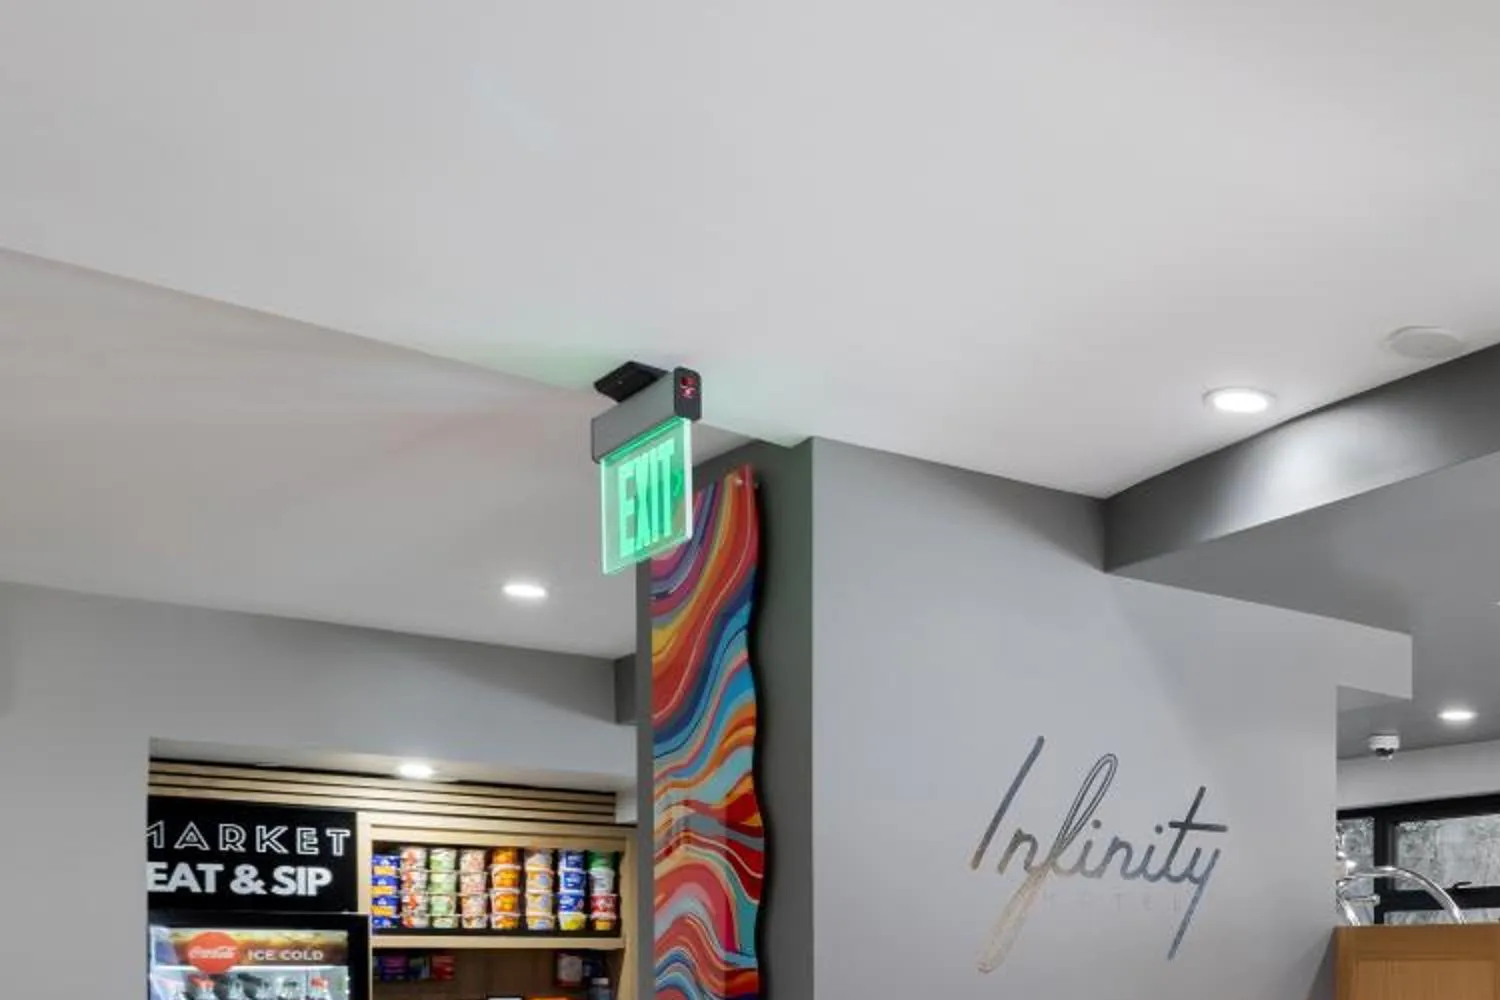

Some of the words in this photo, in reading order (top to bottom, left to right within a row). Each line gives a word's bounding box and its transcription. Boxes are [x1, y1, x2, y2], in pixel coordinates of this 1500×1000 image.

[618, 438, 675, 558] EXIT
[147, 861, 224, 893] EAT
[230, 864, 266, 895] &
[271, 866, 333, 897] SIP
[970, 735, 1228, 973] Infinity
[248, 948, 274, 961] ICE
[280, 949, 324, 961] COLD
